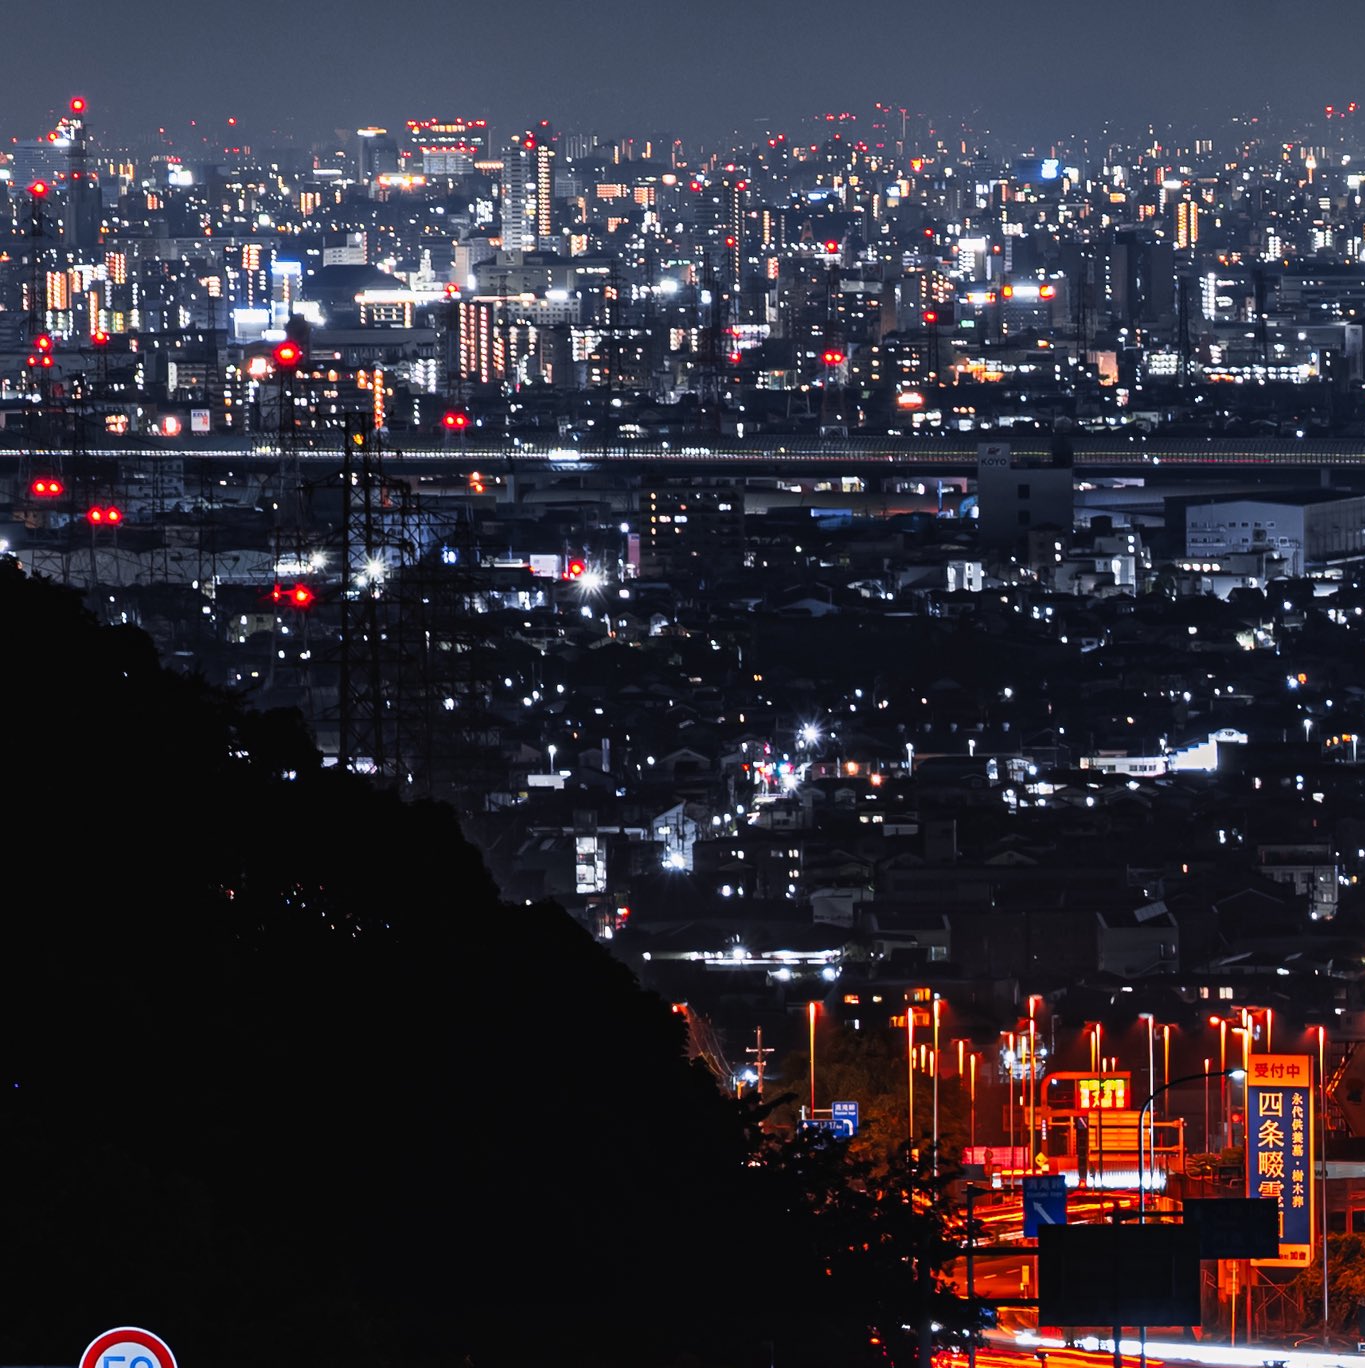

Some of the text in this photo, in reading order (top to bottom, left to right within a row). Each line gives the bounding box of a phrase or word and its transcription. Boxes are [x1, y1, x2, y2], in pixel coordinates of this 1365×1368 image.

[981, 458, 1007, 466] KOYO
[1254, 1063, 1300, 1078] 受付中
